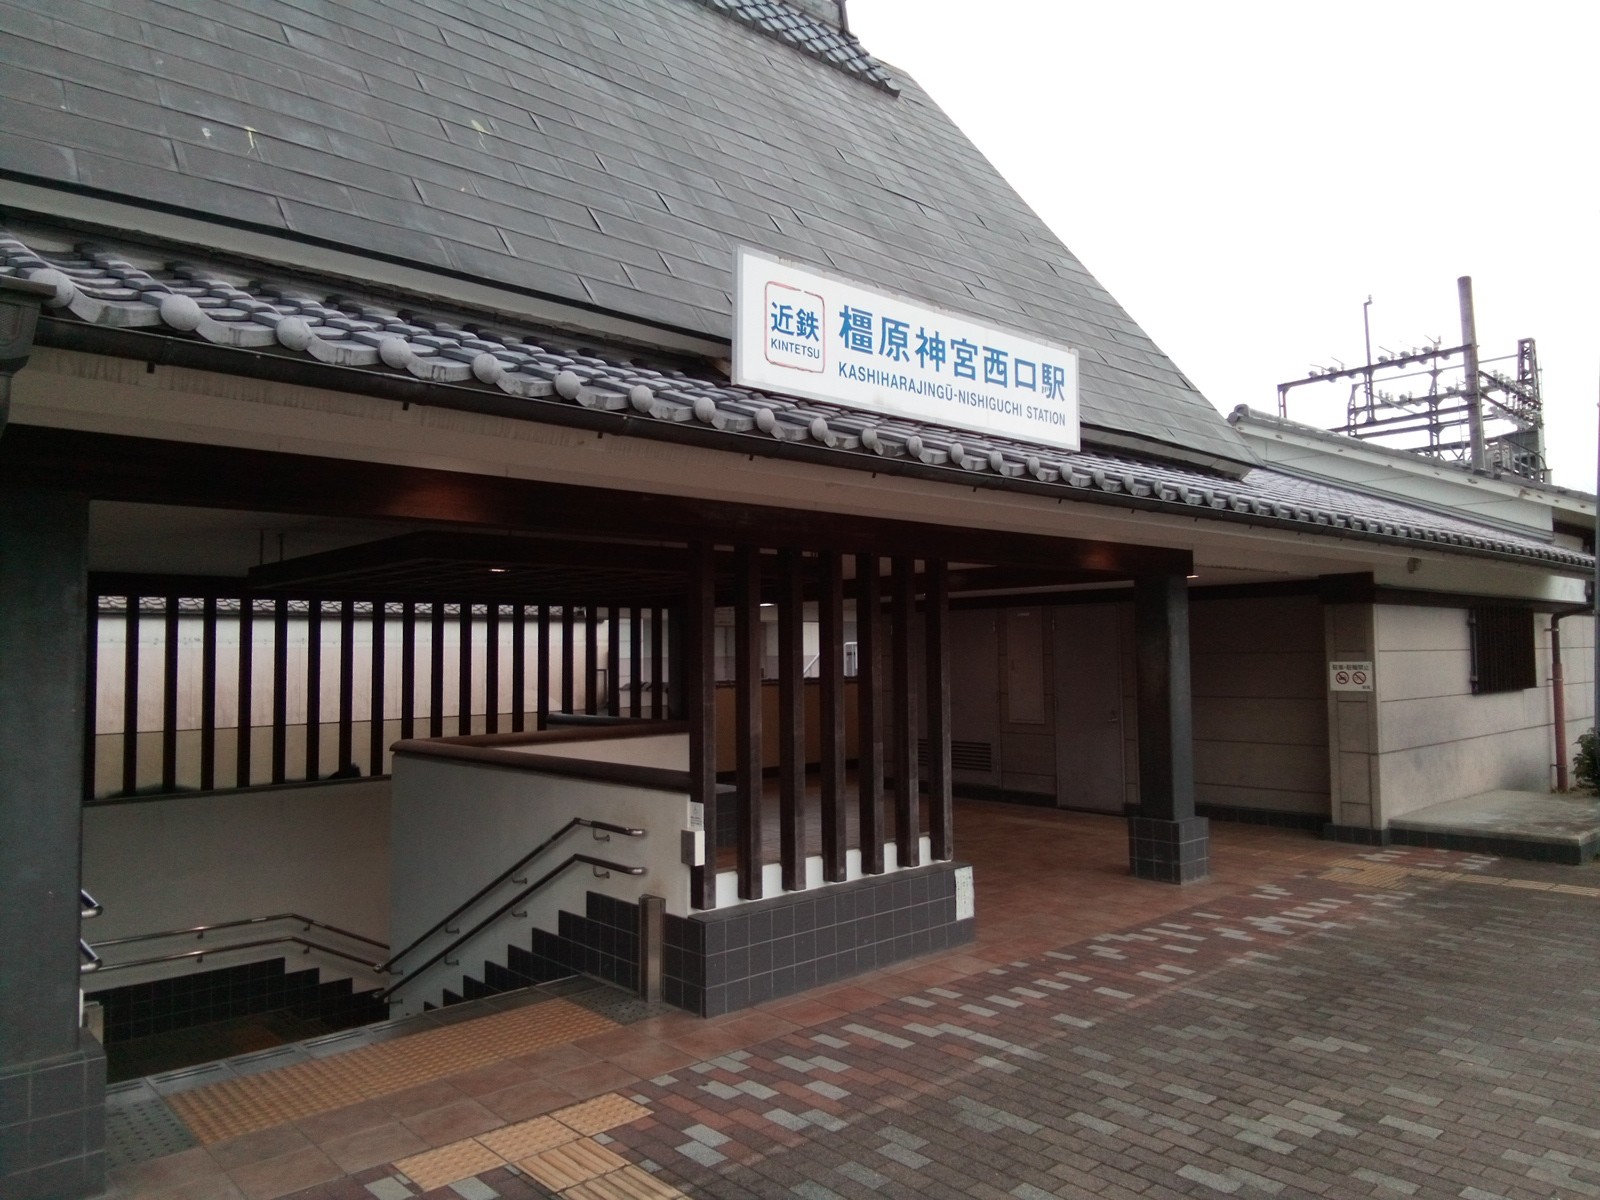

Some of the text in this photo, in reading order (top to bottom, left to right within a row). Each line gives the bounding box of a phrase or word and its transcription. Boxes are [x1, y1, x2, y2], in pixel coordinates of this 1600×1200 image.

[771, 302, 819, 342] 近鉄
[771, 338, 820, 359] KINTETSU
[839, 305, 1065, 401] 橿原神宮西口駅
[839, 361, 1065, 426] KASHIHARAJINGŪ-NISHIGUCHI STATION
